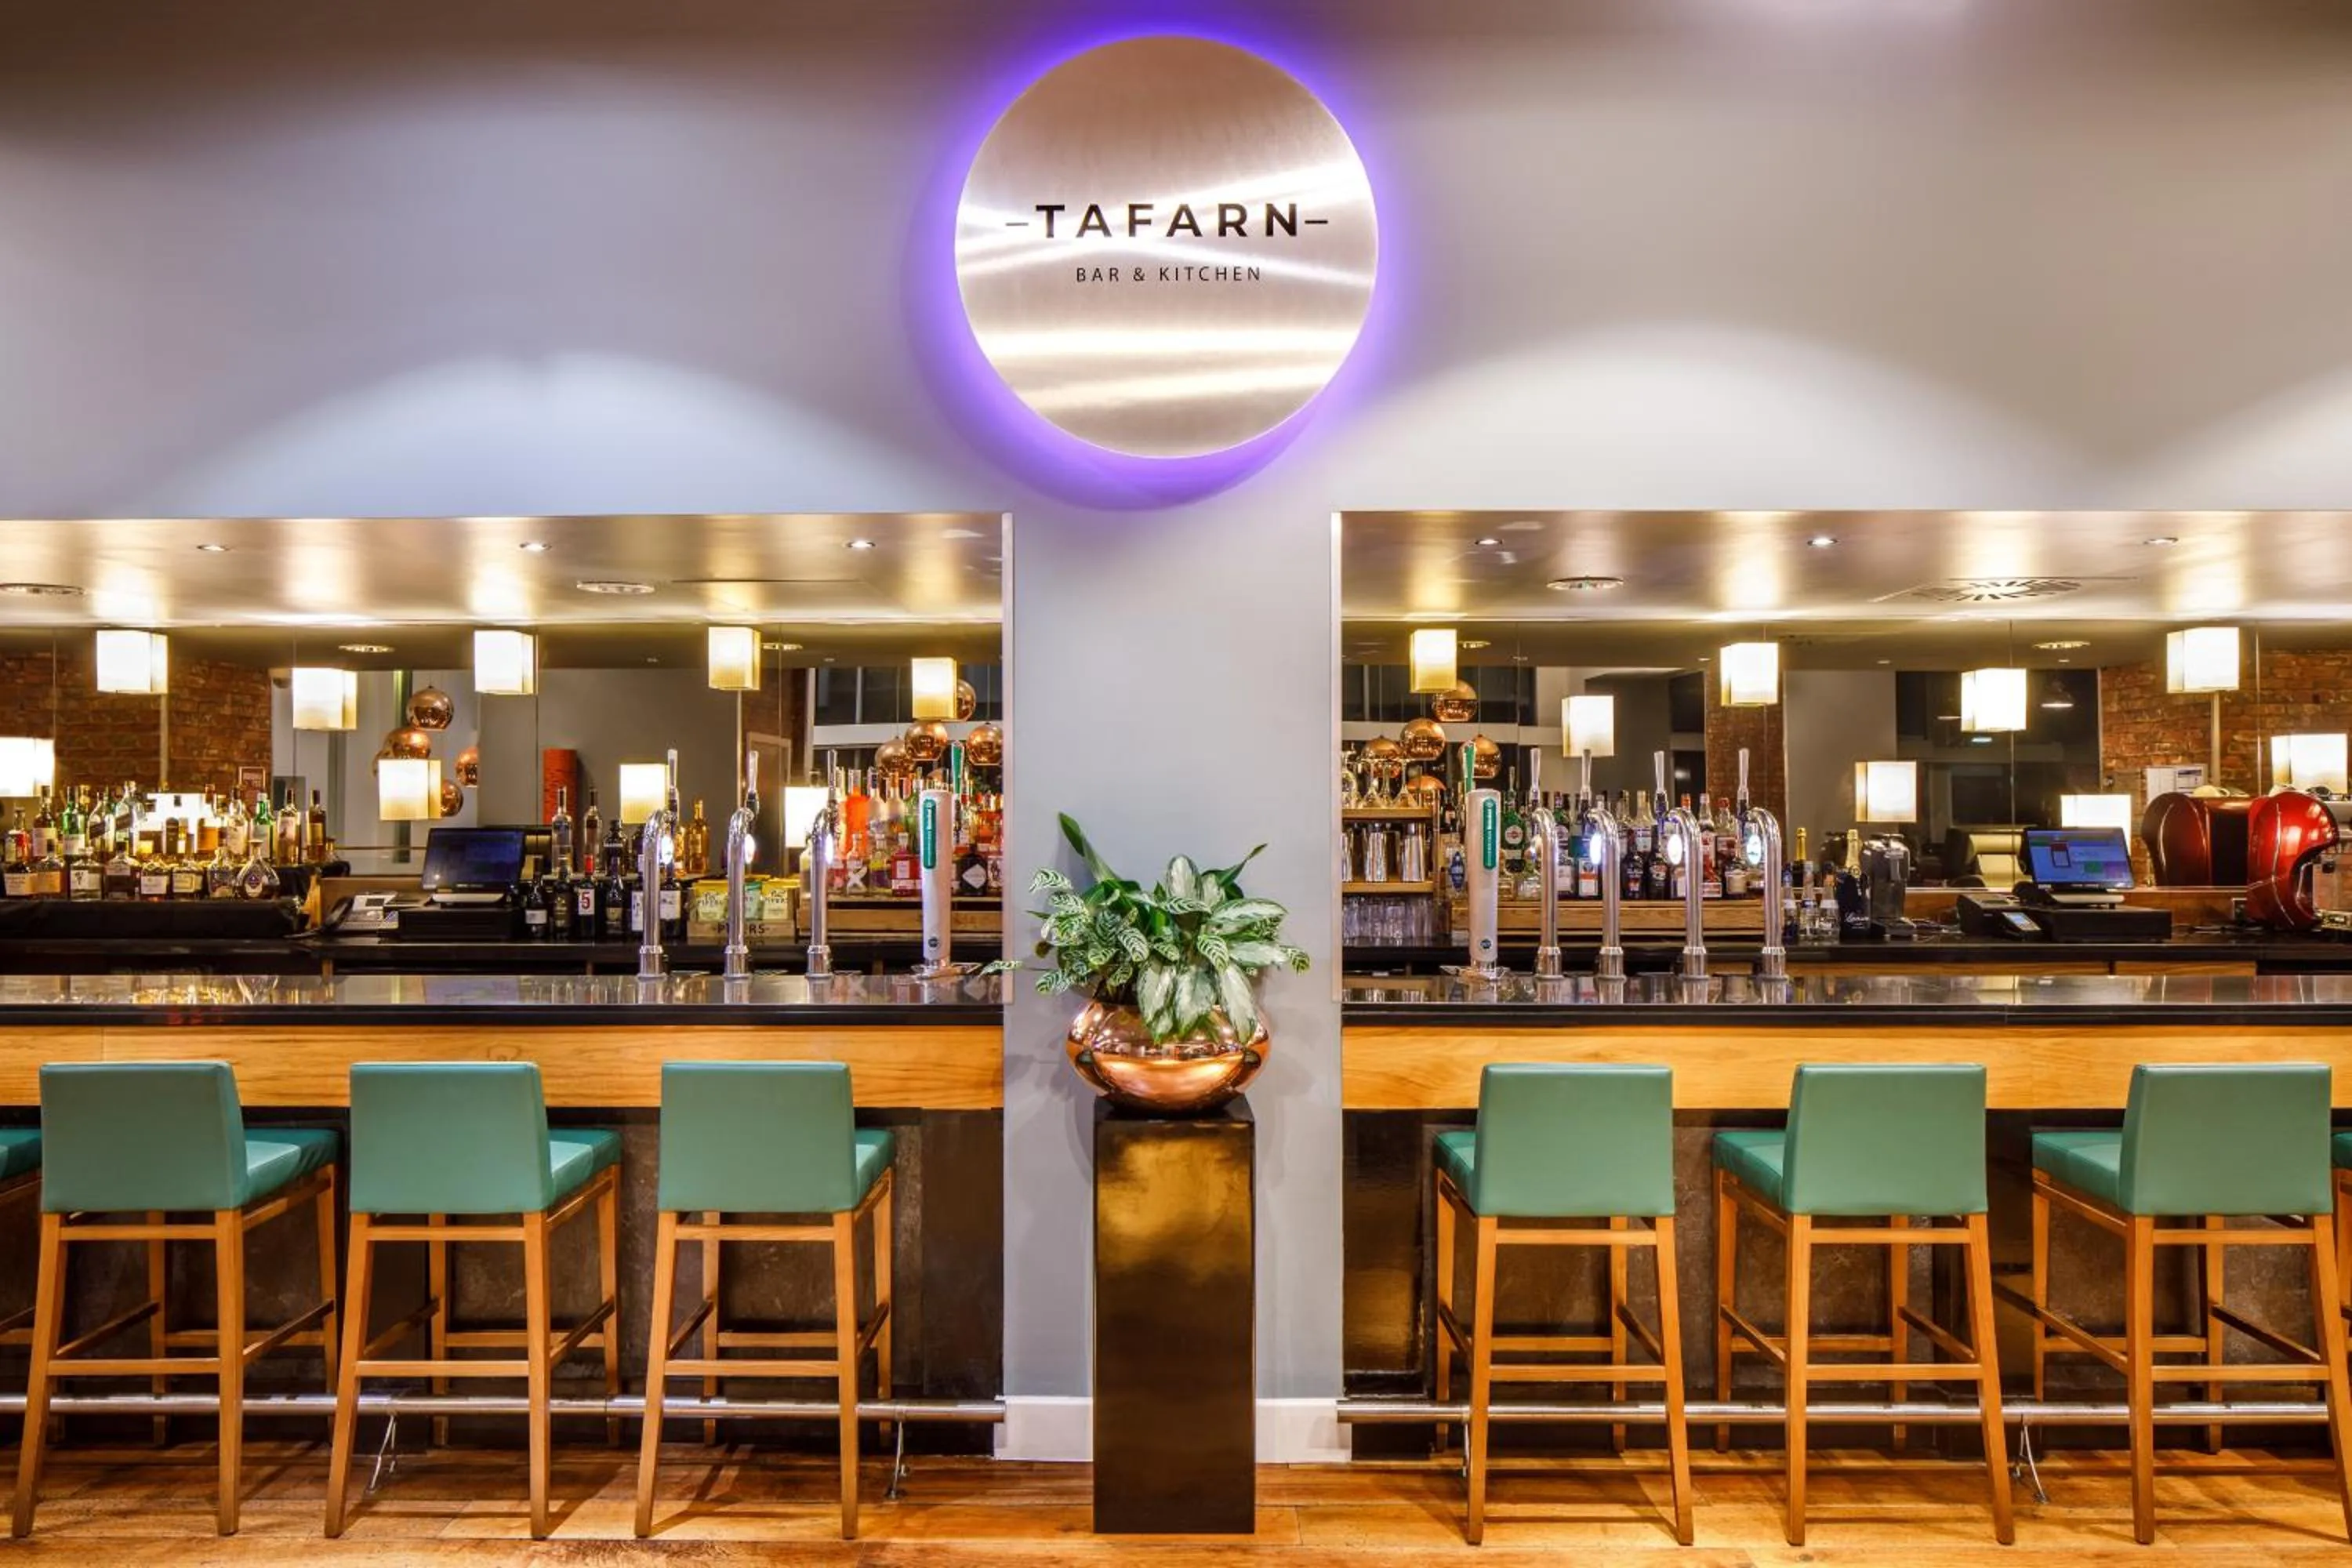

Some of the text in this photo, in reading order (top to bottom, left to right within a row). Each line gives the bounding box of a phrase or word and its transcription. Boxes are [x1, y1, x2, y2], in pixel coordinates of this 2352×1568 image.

[1076, 266, 1261, 282] BAR & KITCHEN
[581, 891, 590, 909] 5
